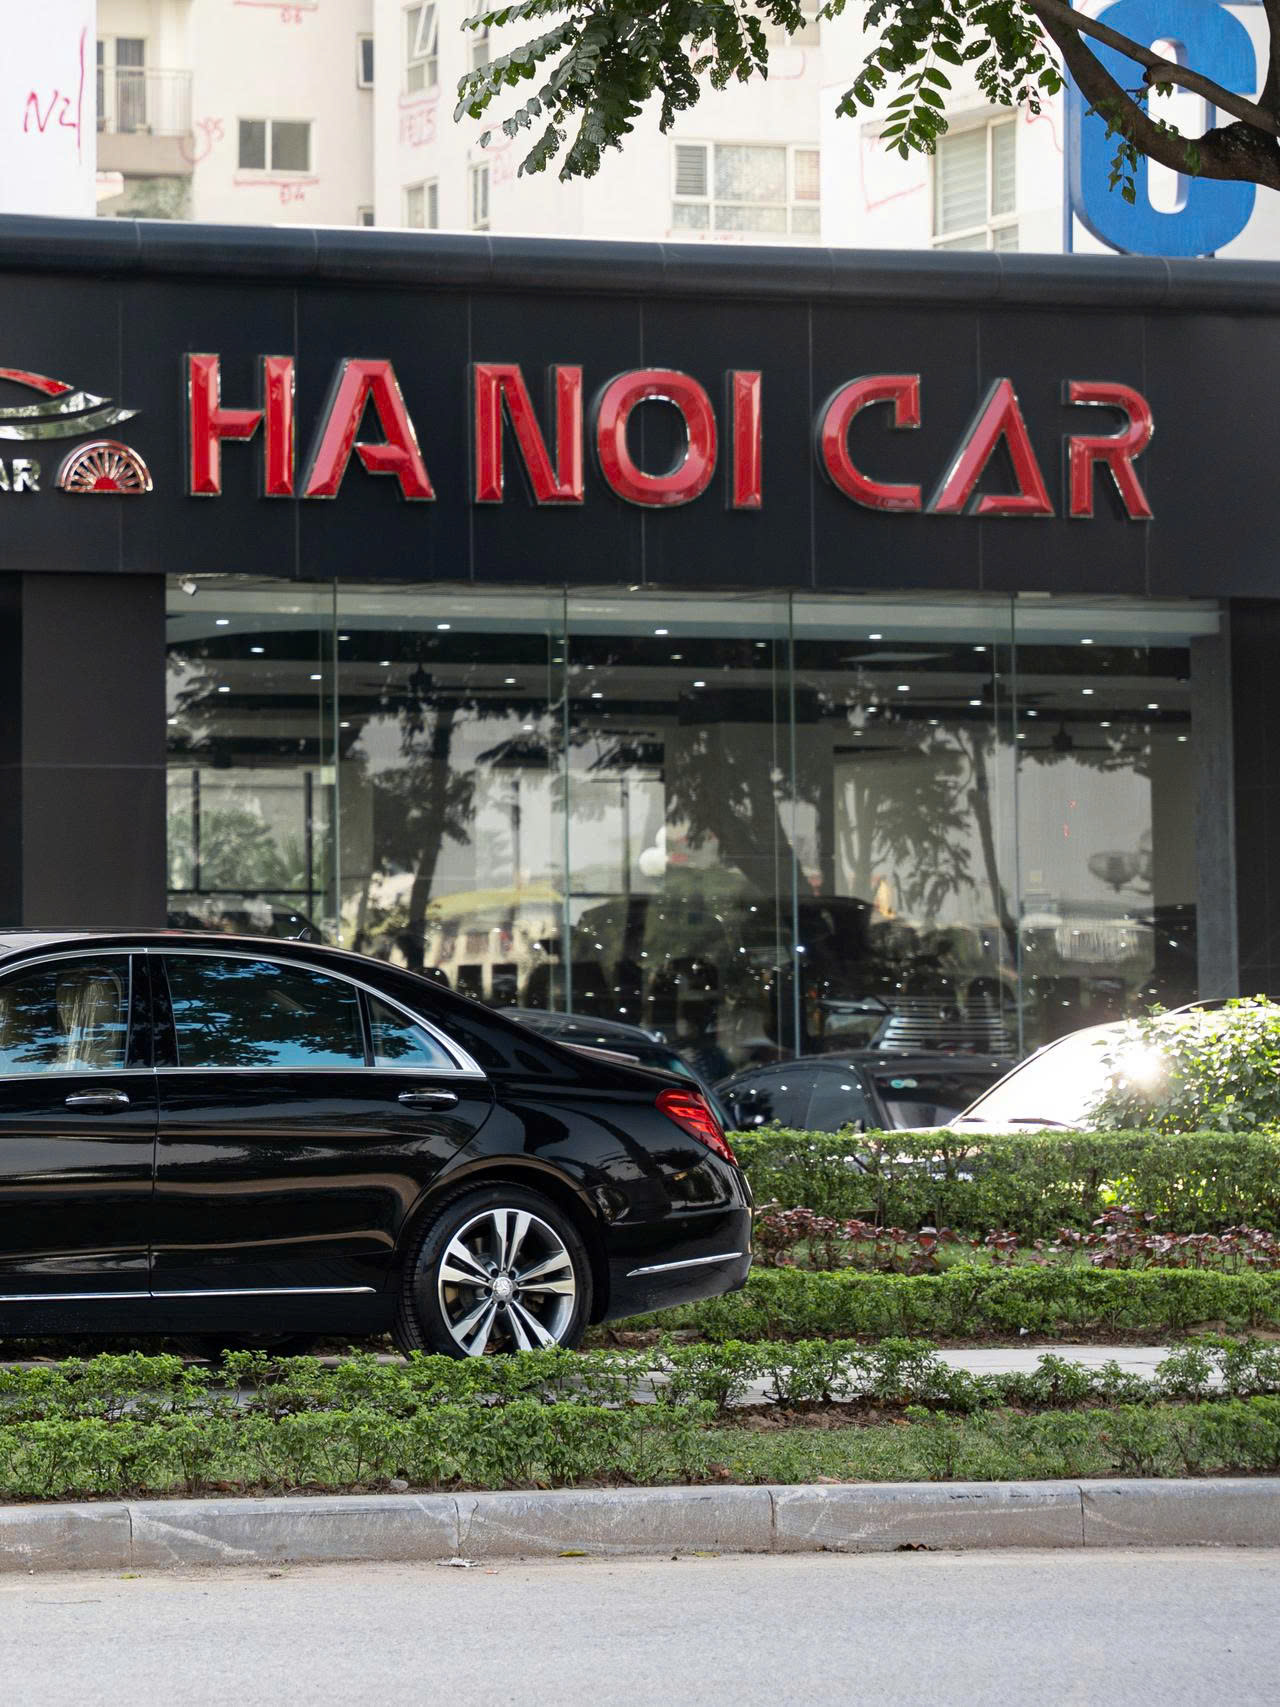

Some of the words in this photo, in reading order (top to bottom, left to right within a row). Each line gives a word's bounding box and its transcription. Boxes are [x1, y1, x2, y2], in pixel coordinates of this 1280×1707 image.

[186, 353, 436, 501] HA
[473, 361, 763, 510] NOI
[818, 373, 1154, 519] CAR
